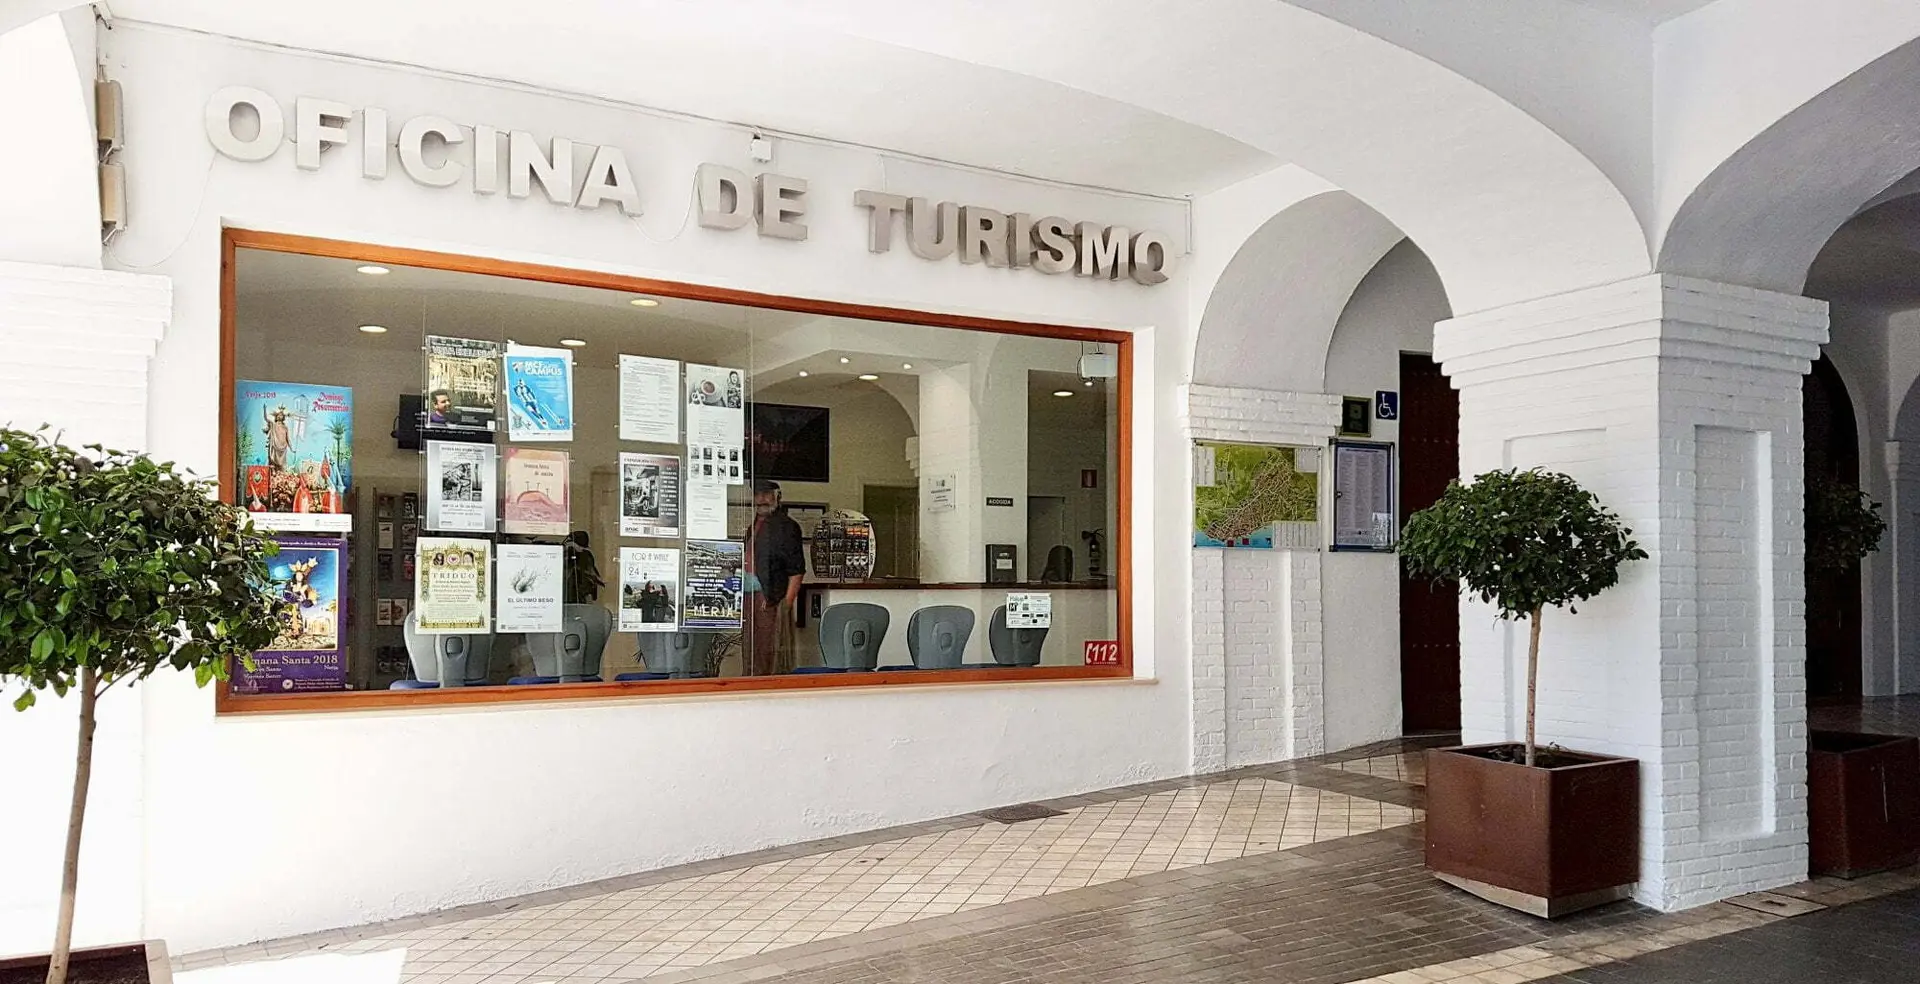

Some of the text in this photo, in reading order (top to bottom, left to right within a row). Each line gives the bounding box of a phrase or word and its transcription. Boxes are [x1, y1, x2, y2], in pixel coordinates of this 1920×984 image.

[205, 84, 1176, 286] OFICINA DE TURISMO
[525, 366, 563, 376] CAMPUS
[281, 655, 311, 665] Santa
[313, 654, 338, 665] 2018
[1092, 643, 1118, 662] 112
